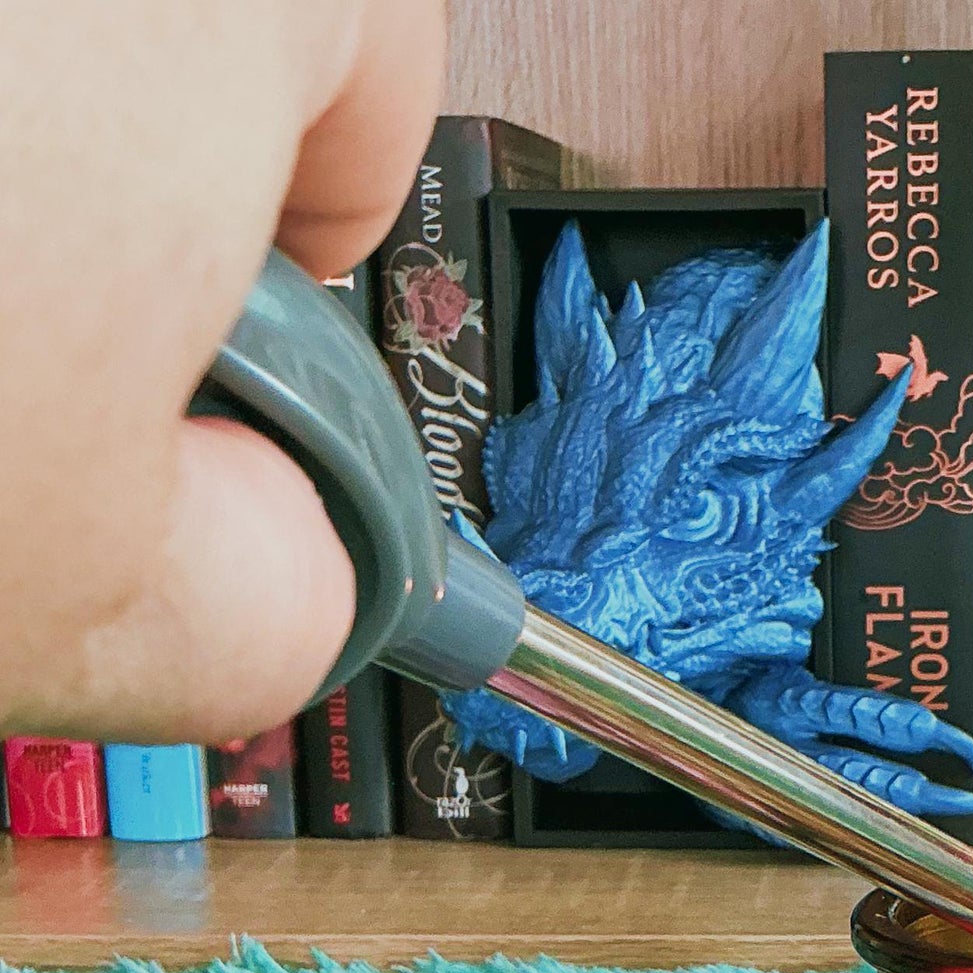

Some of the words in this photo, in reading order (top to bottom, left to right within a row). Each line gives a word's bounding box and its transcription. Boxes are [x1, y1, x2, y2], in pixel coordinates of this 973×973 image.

[419, 164, 443, 244] MEAD
[866, 104, 899, 291] YARROS
[906, 87, 939, 309] REBECCA
[407, 346, 491, 531] Blood
[909, 610, 949, 711] IRON
[223, 783, 269, 794] HARPER
[329, 735, 351, 782] CAST
